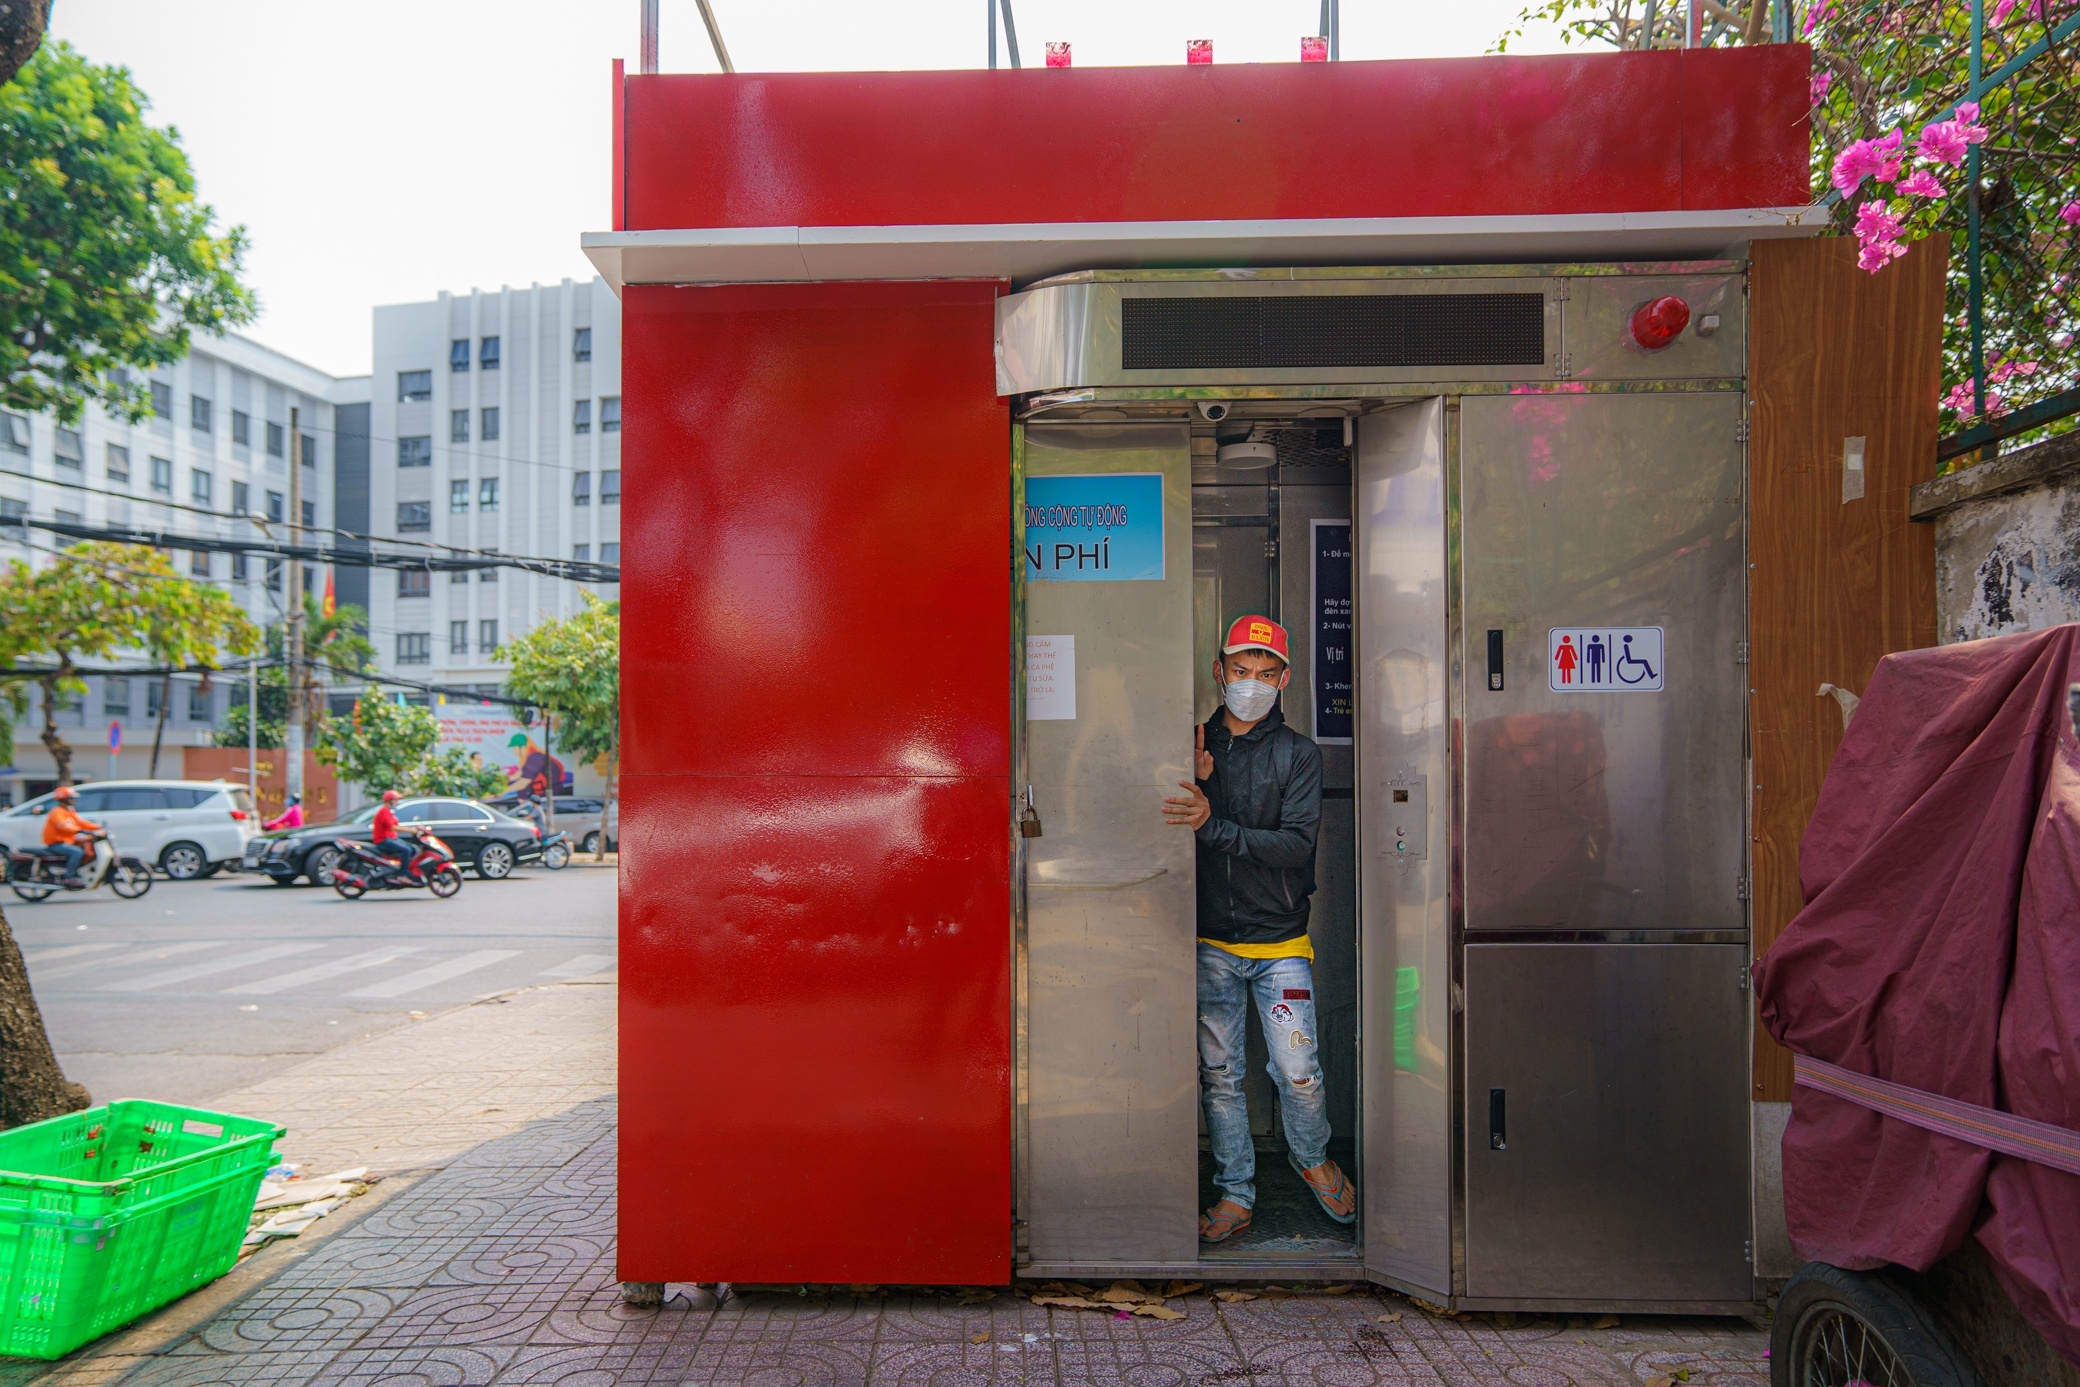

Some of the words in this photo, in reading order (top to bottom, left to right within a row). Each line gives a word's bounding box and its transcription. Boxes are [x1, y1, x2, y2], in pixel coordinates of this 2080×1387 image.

[1047, 504, 1078, 531] CỘNG
[1079, 505, 1095, 531] TỰ
[1096, 503, 1128, 531] ĐỘNG
[1055, 536, 1111, 571] PHÍ
[1324, 598, 1339, 608] Hãy
[1332, 621, 1345, 630] Nút
[1326, 646, 1334, 664] Vị
[1335, 646, 1344, 661] trí
